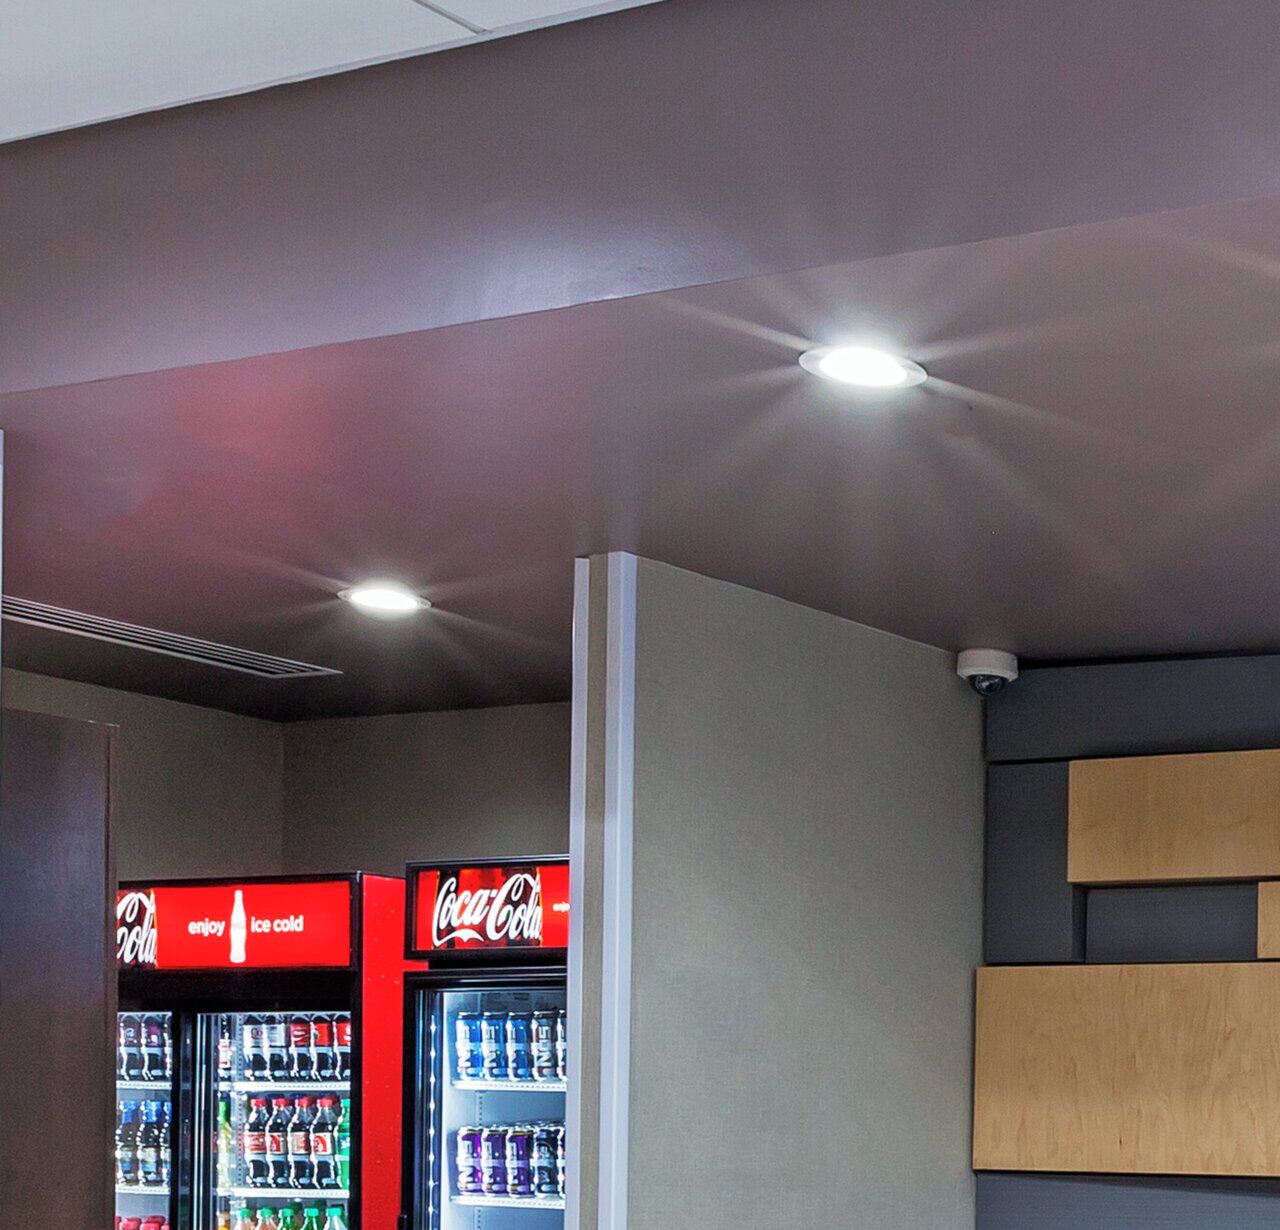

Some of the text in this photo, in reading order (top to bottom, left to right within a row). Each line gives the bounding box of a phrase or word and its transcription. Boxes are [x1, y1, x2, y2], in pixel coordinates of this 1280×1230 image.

[432, 873, 543, 947] Coca-Cola
[188, 918, 226, 937] enjoy
[251, 915, 304, 933] ice cold
